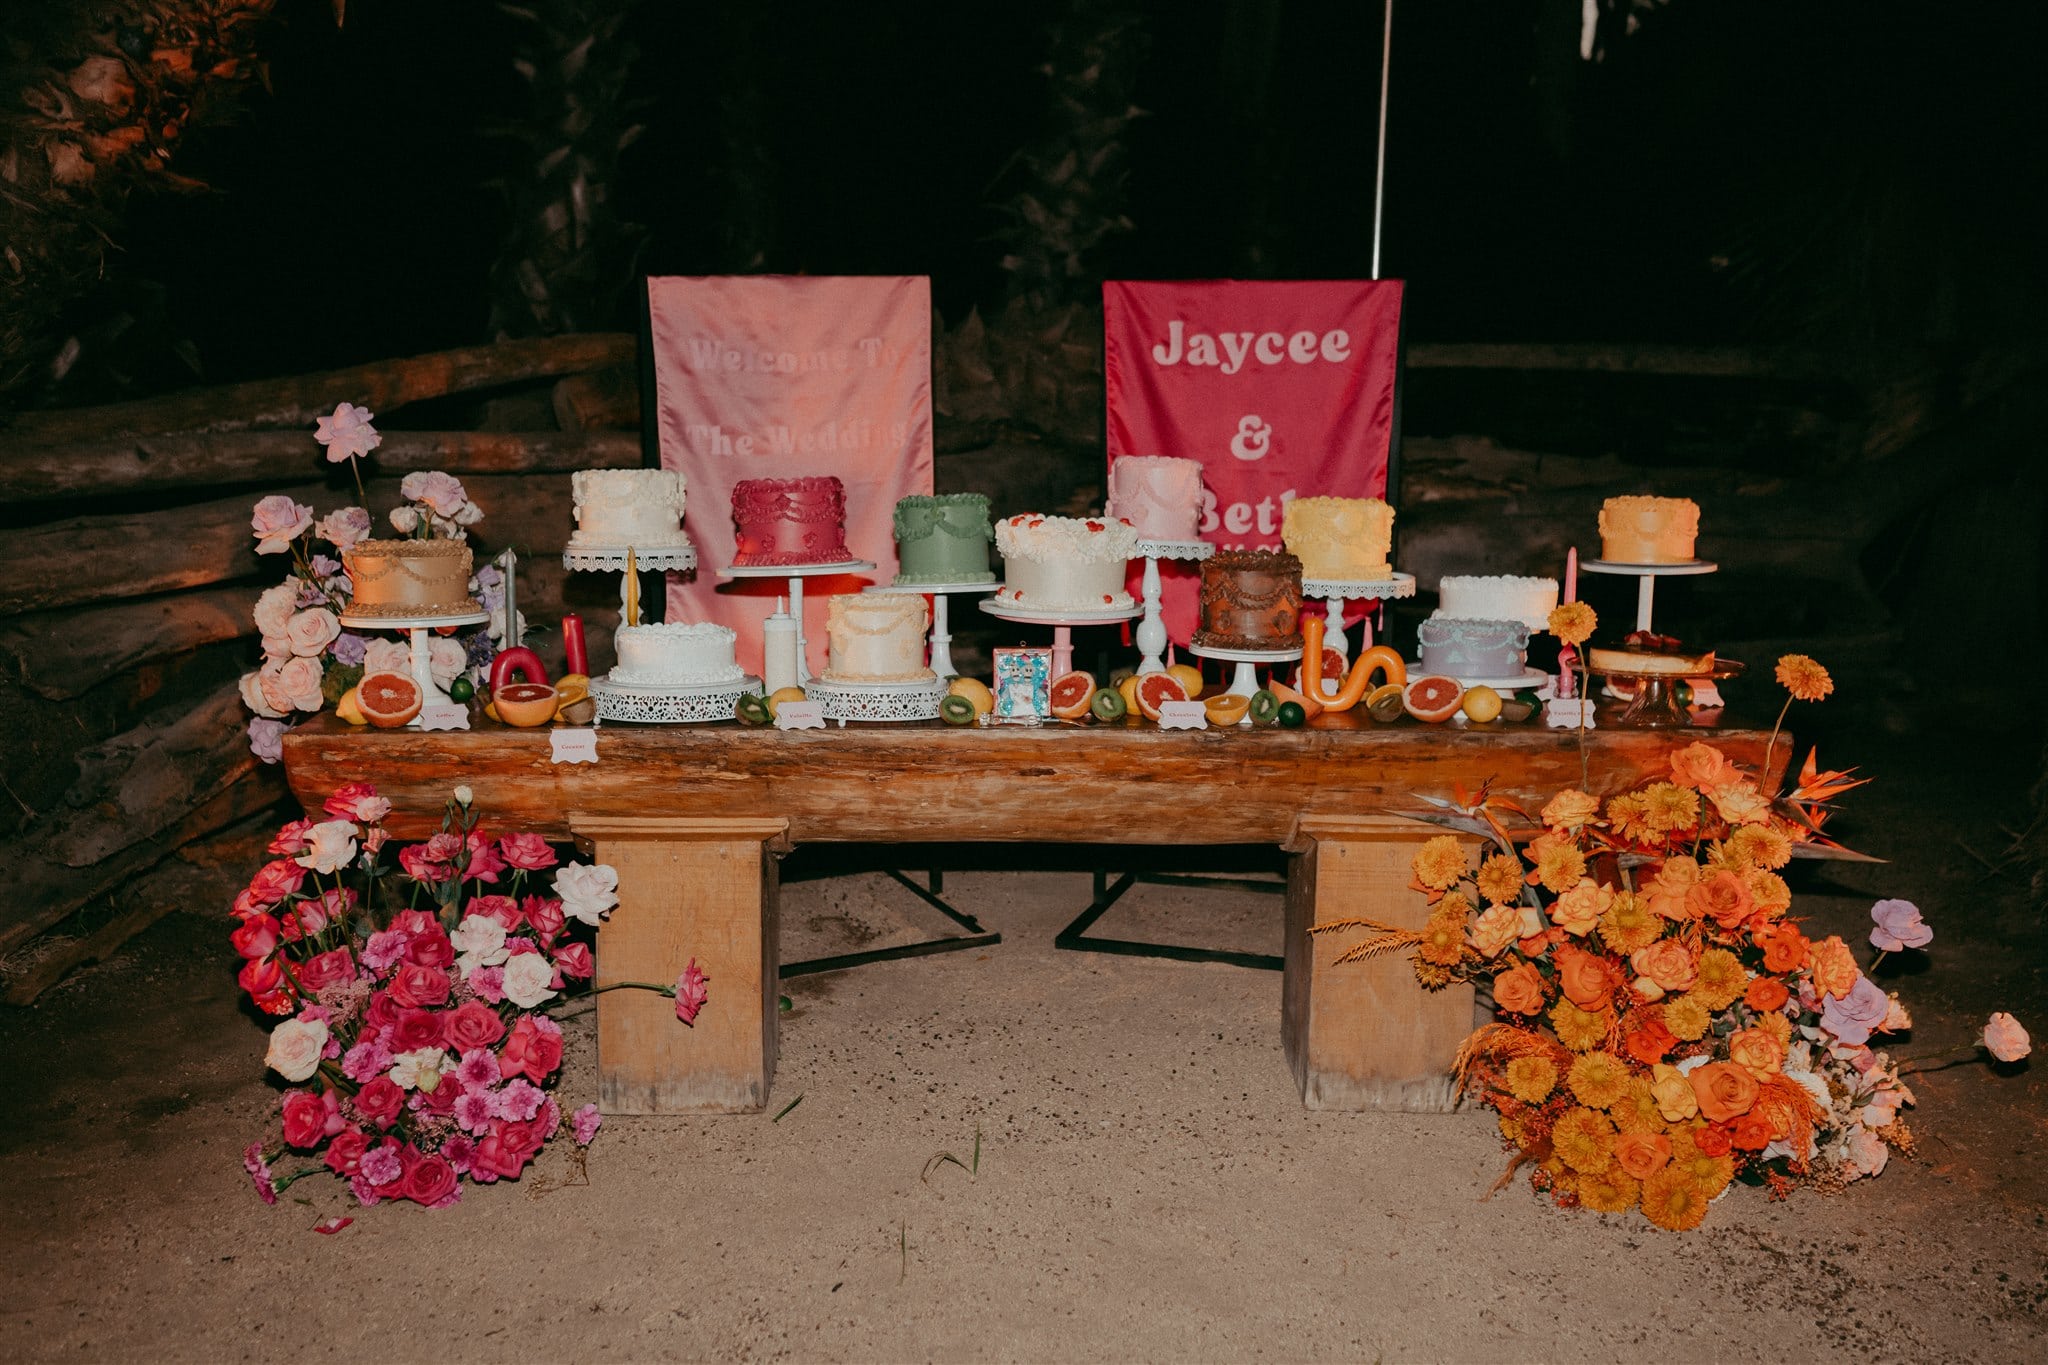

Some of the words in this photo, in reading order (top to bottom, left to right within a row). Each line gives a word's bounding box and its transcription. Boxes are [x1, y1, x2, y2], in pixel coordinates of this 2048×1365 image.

[688, 338, 849, 373] Welcome
[859, 337, 899, 368] To
[1152, 320, 1351, 375] Jaycee
[687, 423, 755, 456] The
[1230, 414, 1273, 461] &
